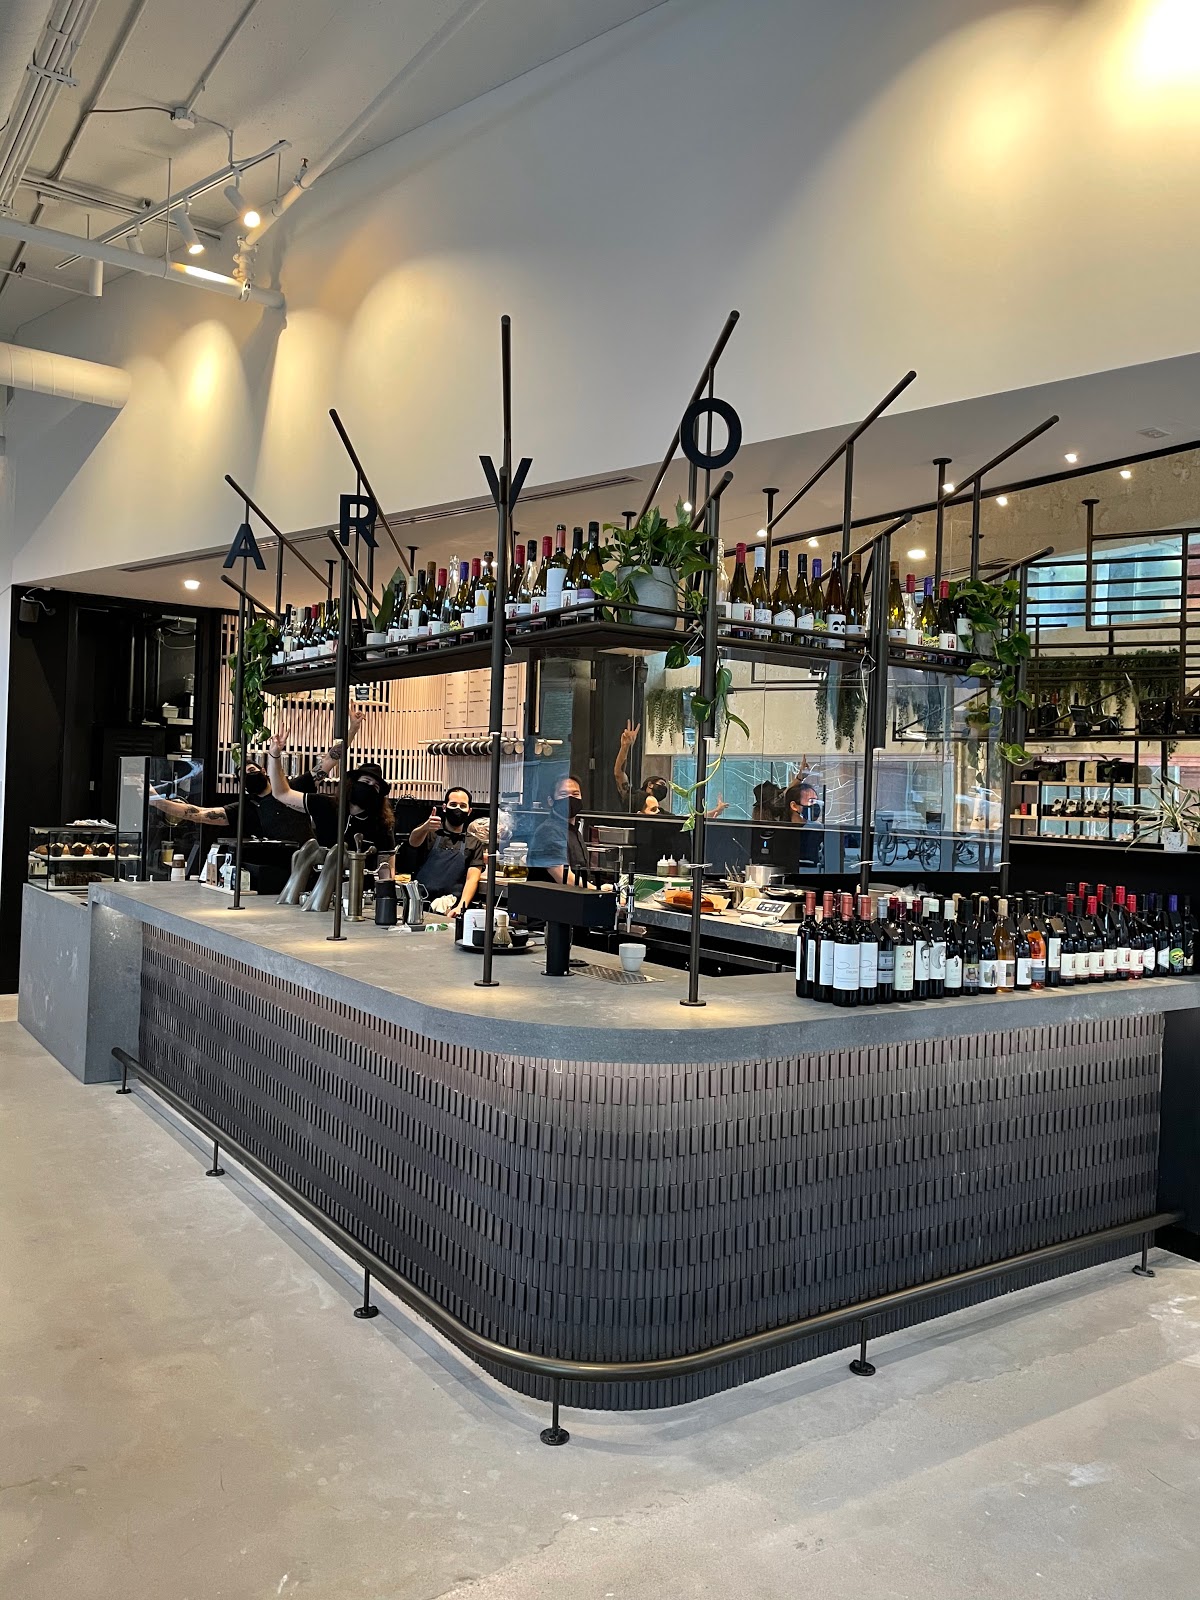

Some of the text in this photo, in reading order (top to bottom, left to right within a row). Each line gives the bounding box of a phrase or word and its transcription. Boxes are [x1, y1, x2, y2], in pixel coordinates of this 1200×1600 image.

[223, 524, 266, 570] A
[339, 494, 380, 548] R
[680, 397, 742, 469] O
